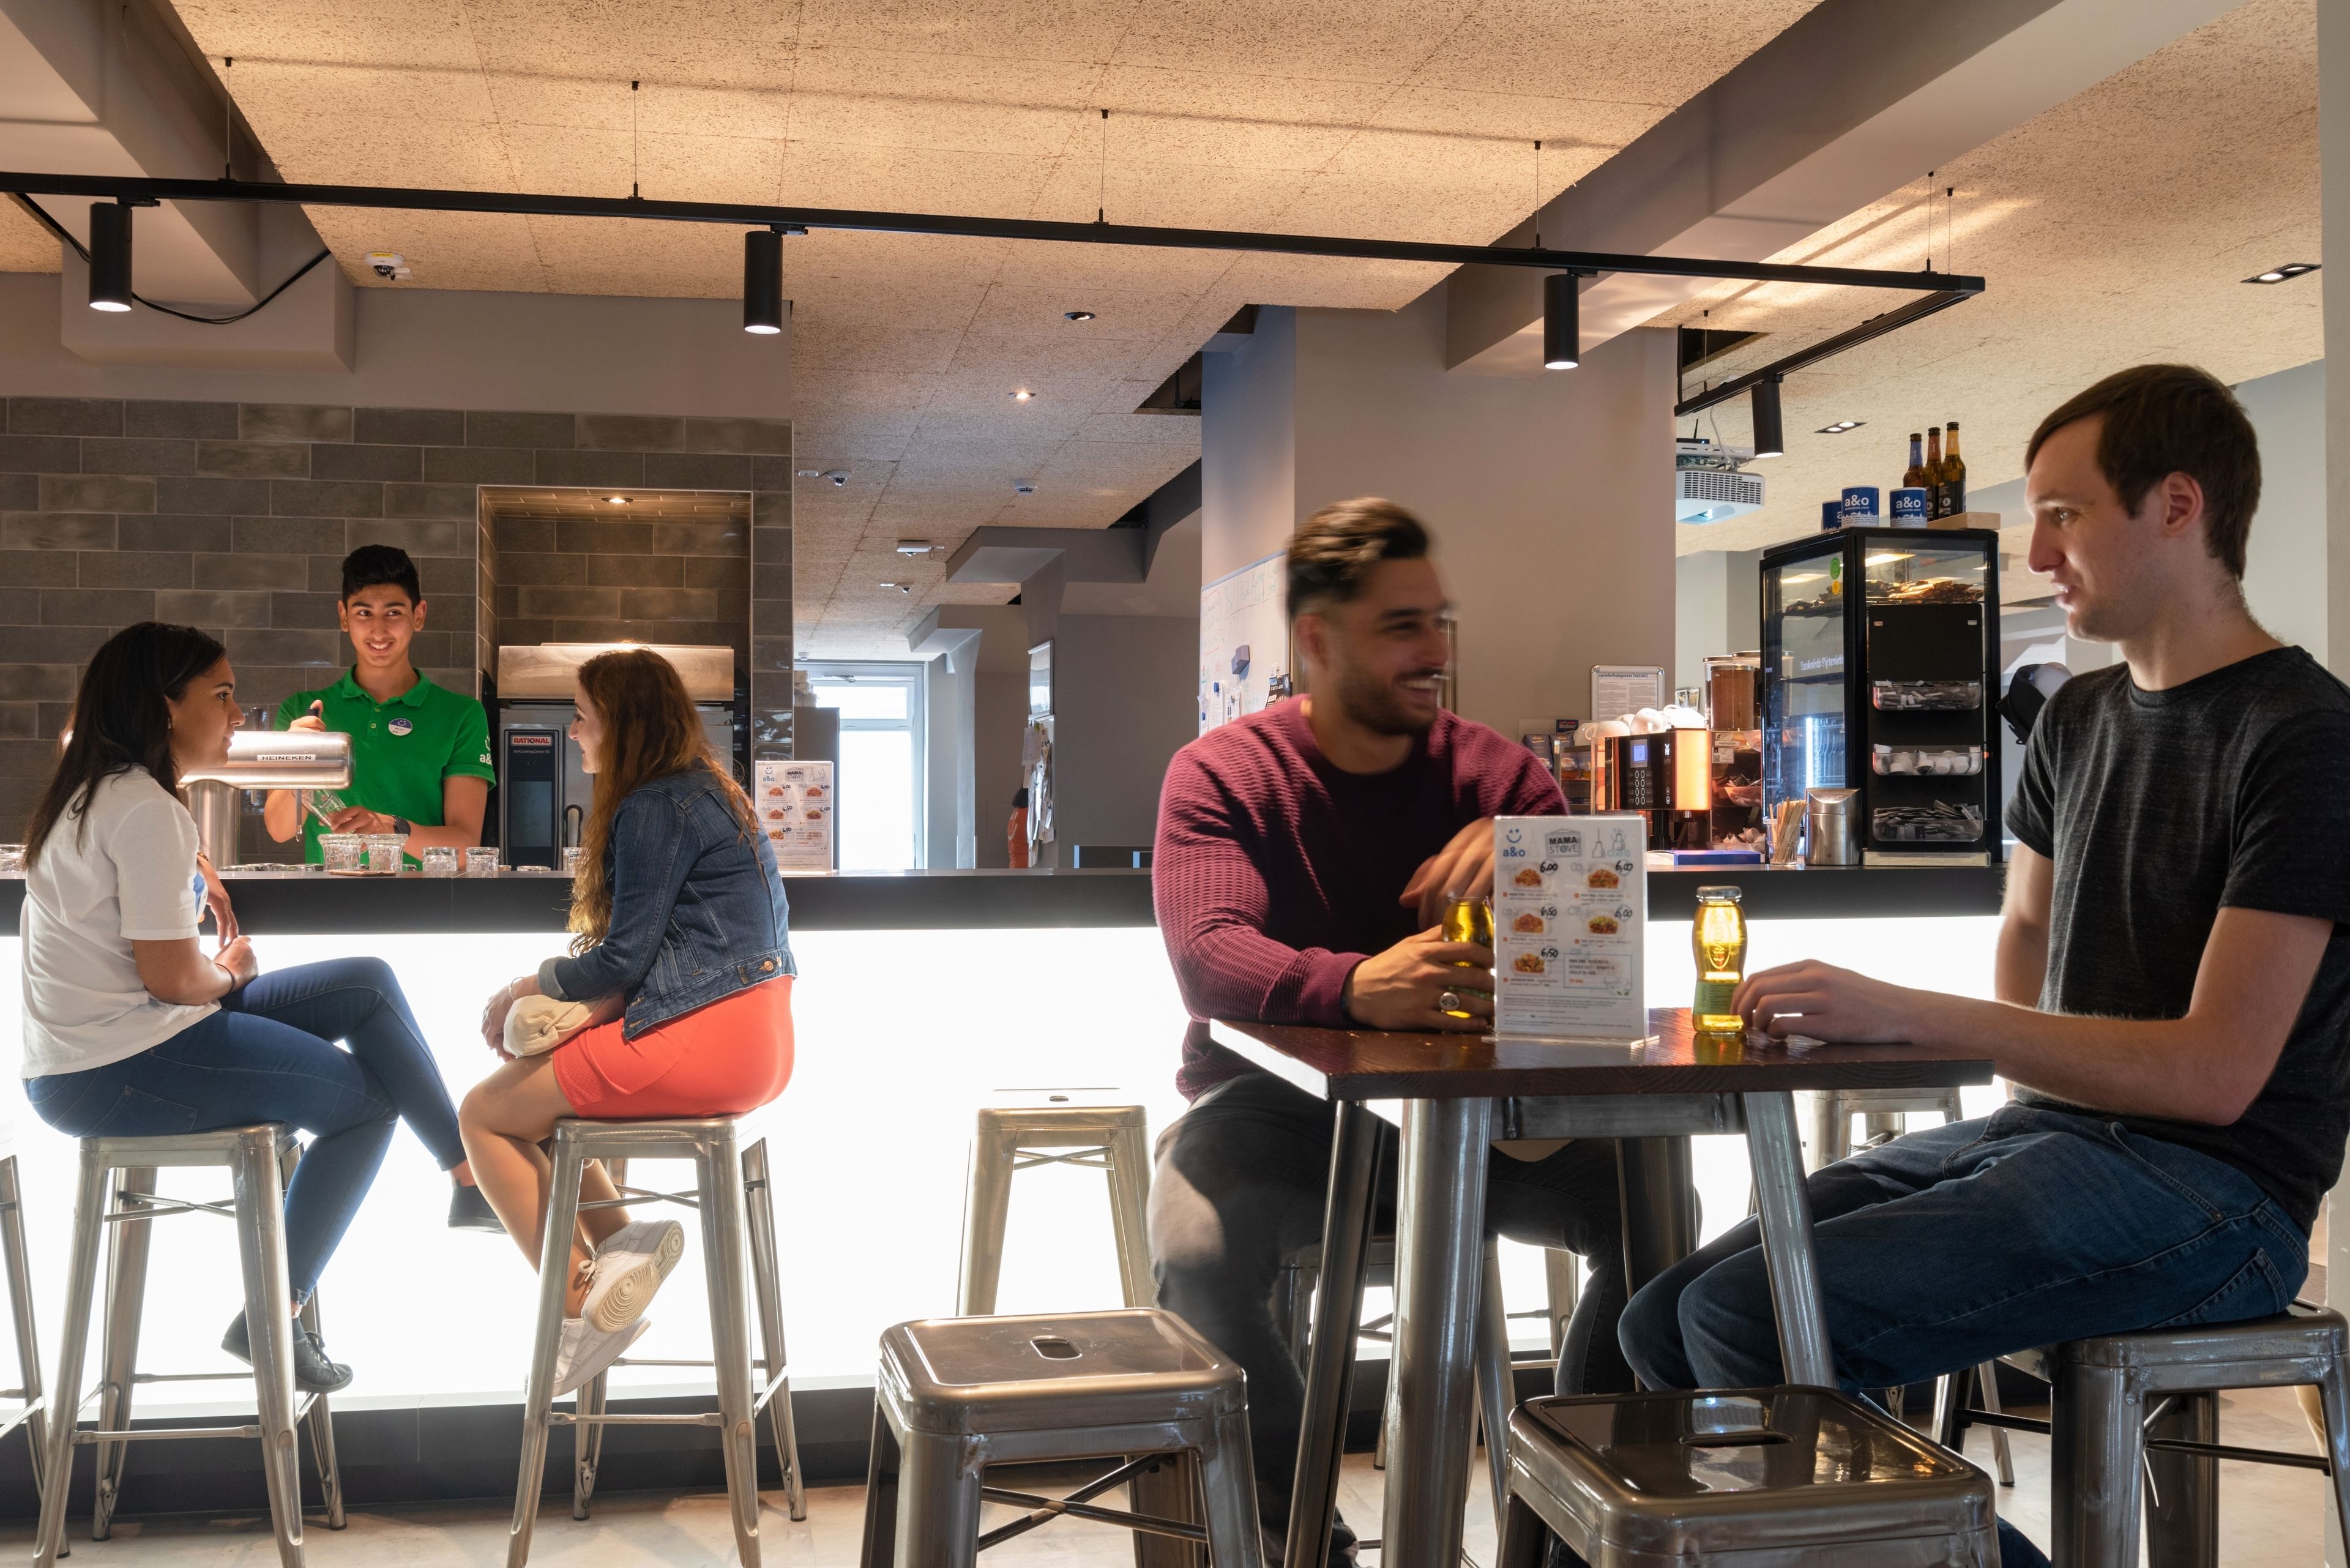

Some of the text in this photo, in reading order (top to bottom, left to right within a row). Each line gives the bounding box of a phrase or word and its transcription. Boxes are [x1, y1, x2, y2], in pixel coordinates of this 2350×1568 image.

[1845, 495, 1870, 507] a&o
[1896, 496, 1921, 509] a&o
[479, 753, 493, 766] a&
[1502, 846, 1526, 857] a&o
[1550, 845, 1578, 854] STOVE
[1616, 861, 1634, 873] 6,00
[1614, 908, 1633, 919] 6,00
[1541, 948, 1559, 958] 6,50
